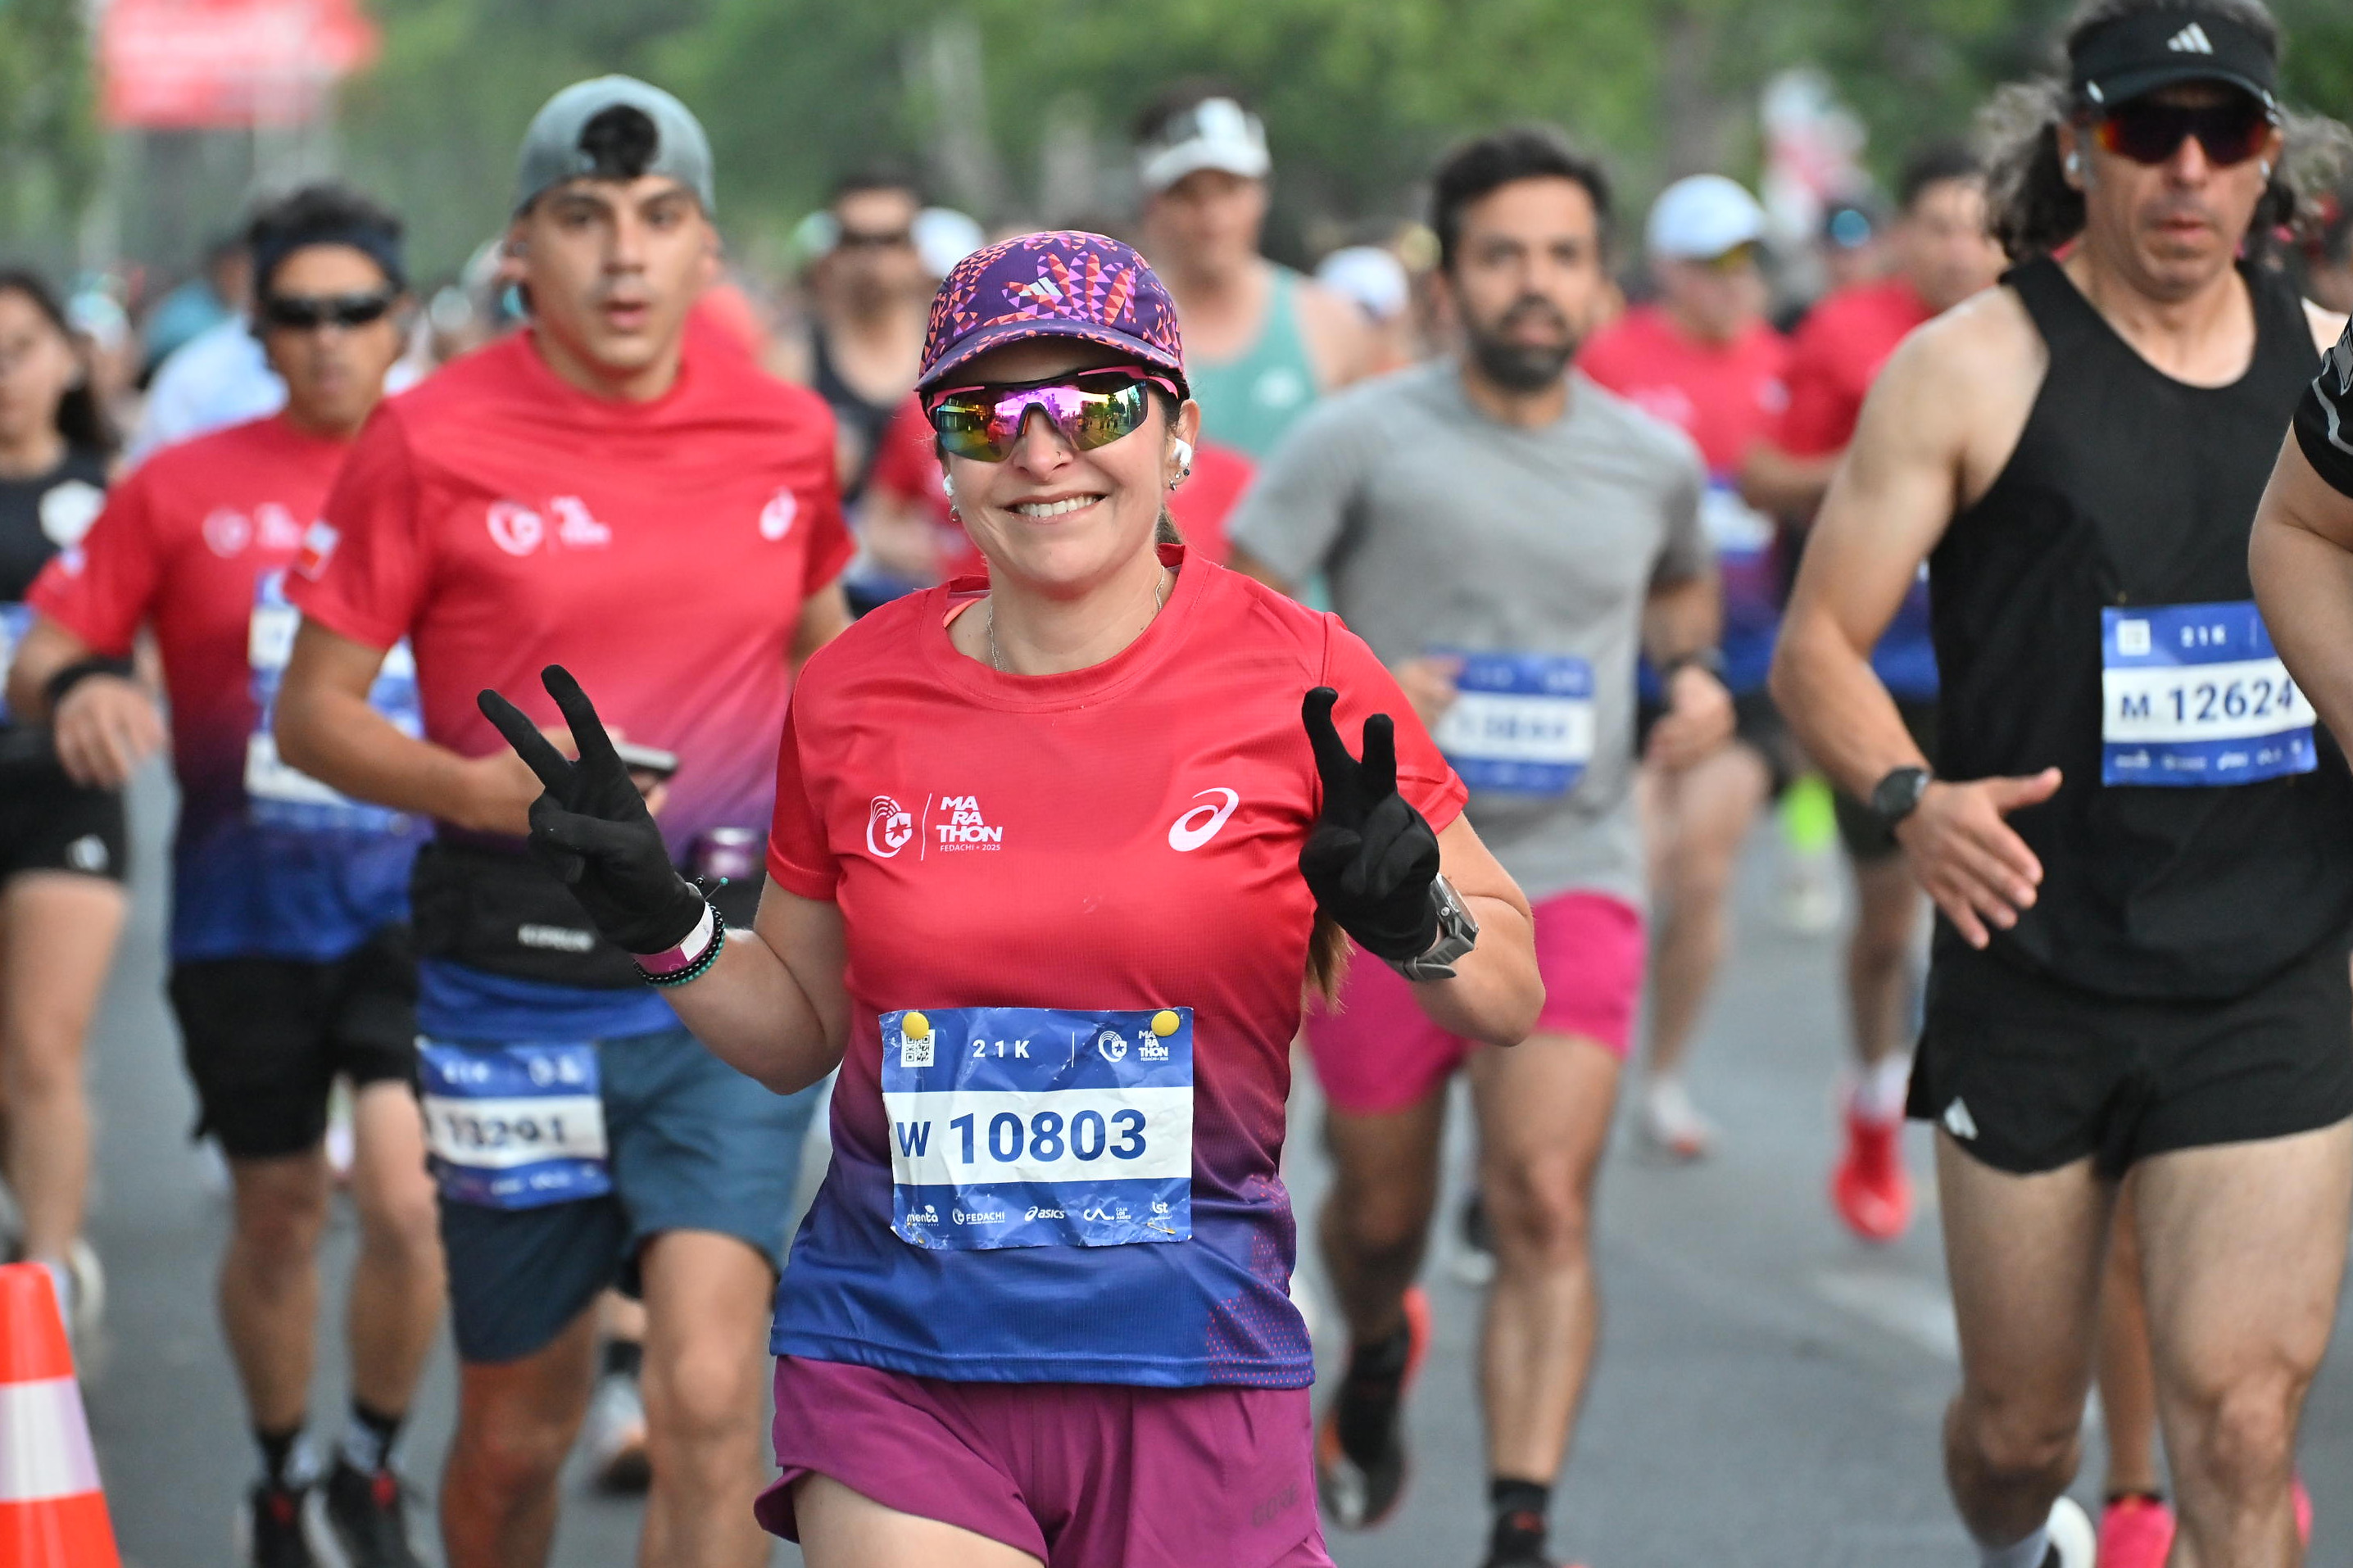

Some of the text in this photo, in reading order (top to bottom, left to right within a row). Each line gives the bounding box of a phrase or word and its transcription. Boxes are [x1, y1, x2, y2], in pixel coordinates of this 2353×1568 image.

[2121, 678, 2292, 722] M 12624
[940, 795, 979, 811] MA
[951, 811, 984, 826] RA
[936, 824, 1003, 843] THON
[940, 844, 974, 852] FEDACHI
[1138, 1030, 1157, 1040] MA
[1144, 1038, 1160, 1048] RA
[972, 1040, 1030, 1059] 21K
[1138, 1046, 1168, 1058] THON
[896, 1108, 1146, 1164] W 10803
[906, 1212, 939, 1223] menta
[966, 1211, 1005, 1221] FEDACHI
[1037, 1208, 1065, 1219] asics
